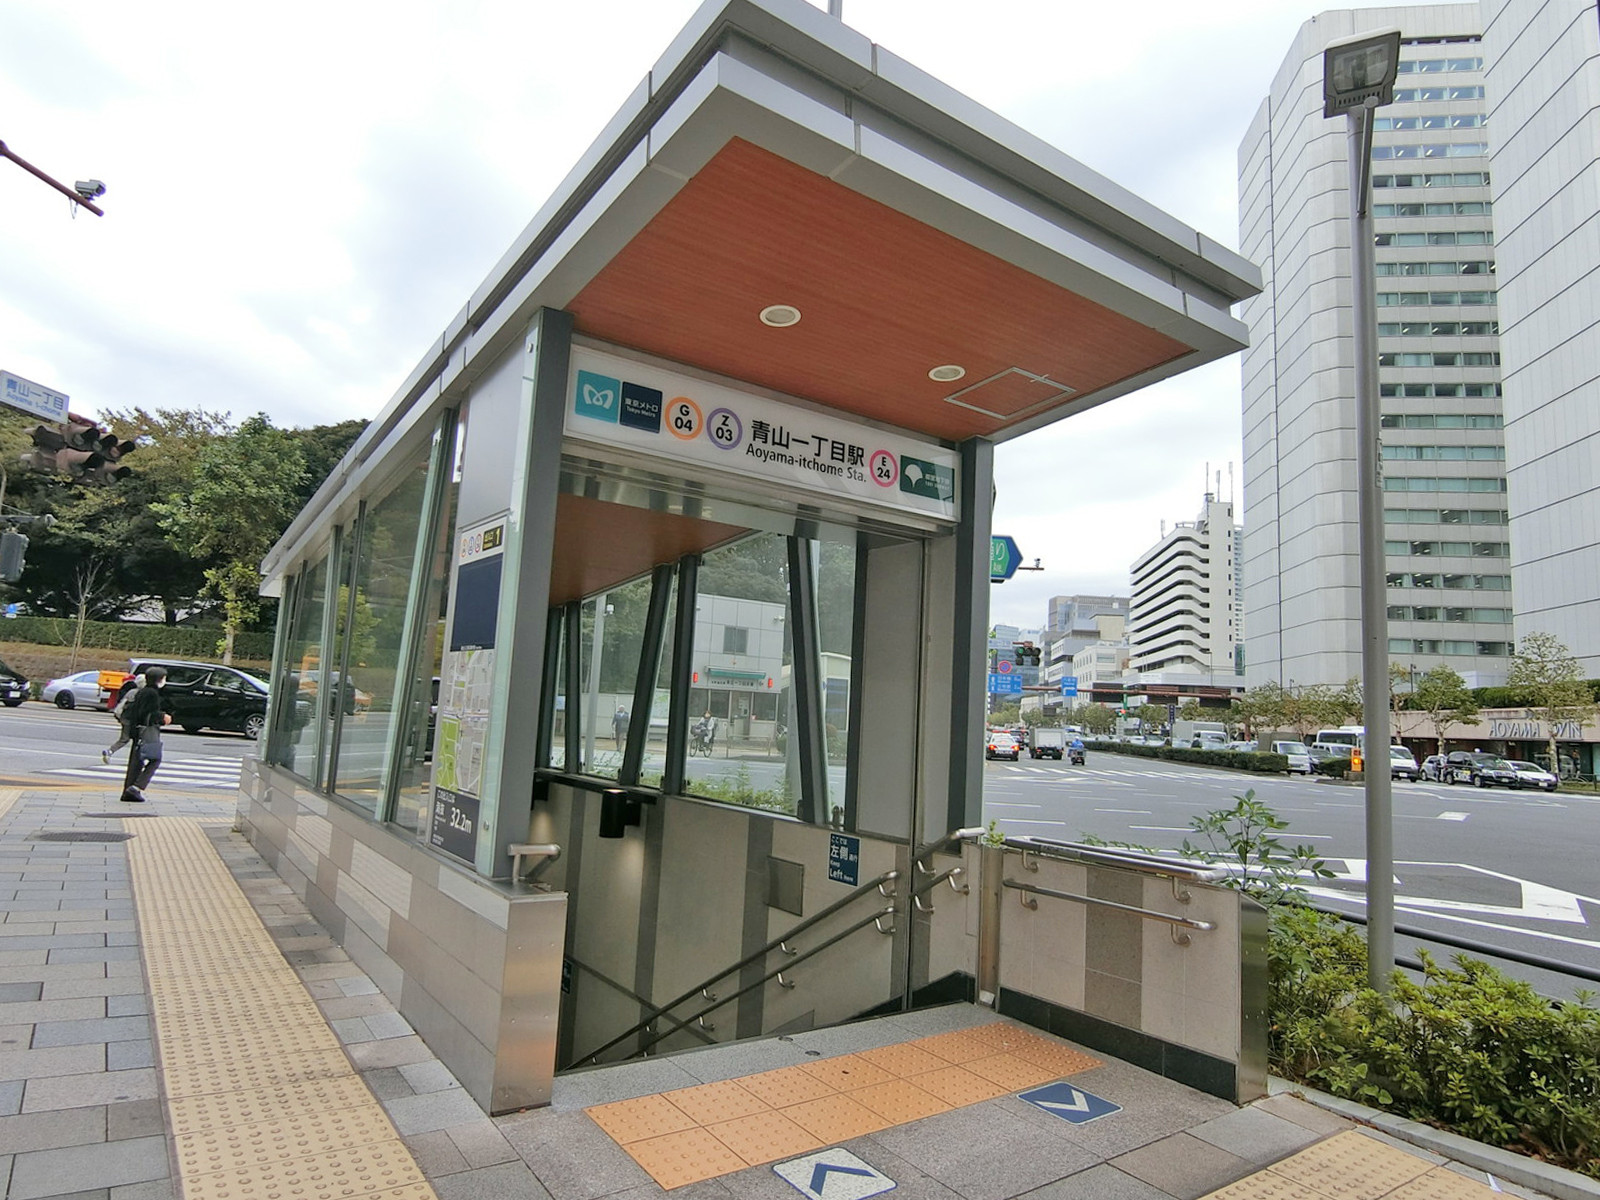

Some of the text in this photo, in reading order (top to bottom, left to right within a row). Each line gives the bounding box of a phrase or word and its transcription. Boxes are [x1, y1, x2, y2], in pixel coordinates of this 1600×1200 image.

[679, 404, 690, 417] G
[674, 416, 693, 432] 04
[720, 415, 730, 427] Z
[715, 427, 733, 442] 03
[751, 420, 865, 467] 青山一丁目駅
[746, 443, 867, 482] Aoyama-itchome Sta.
[881, 456, 888, 467] E
[877, 467, 891, 480] 24
[1490, 720, 1541, 738] AOYAMA
[450, 807, 472, 834] 32.2m
[829, 868, 843, 880] Left
